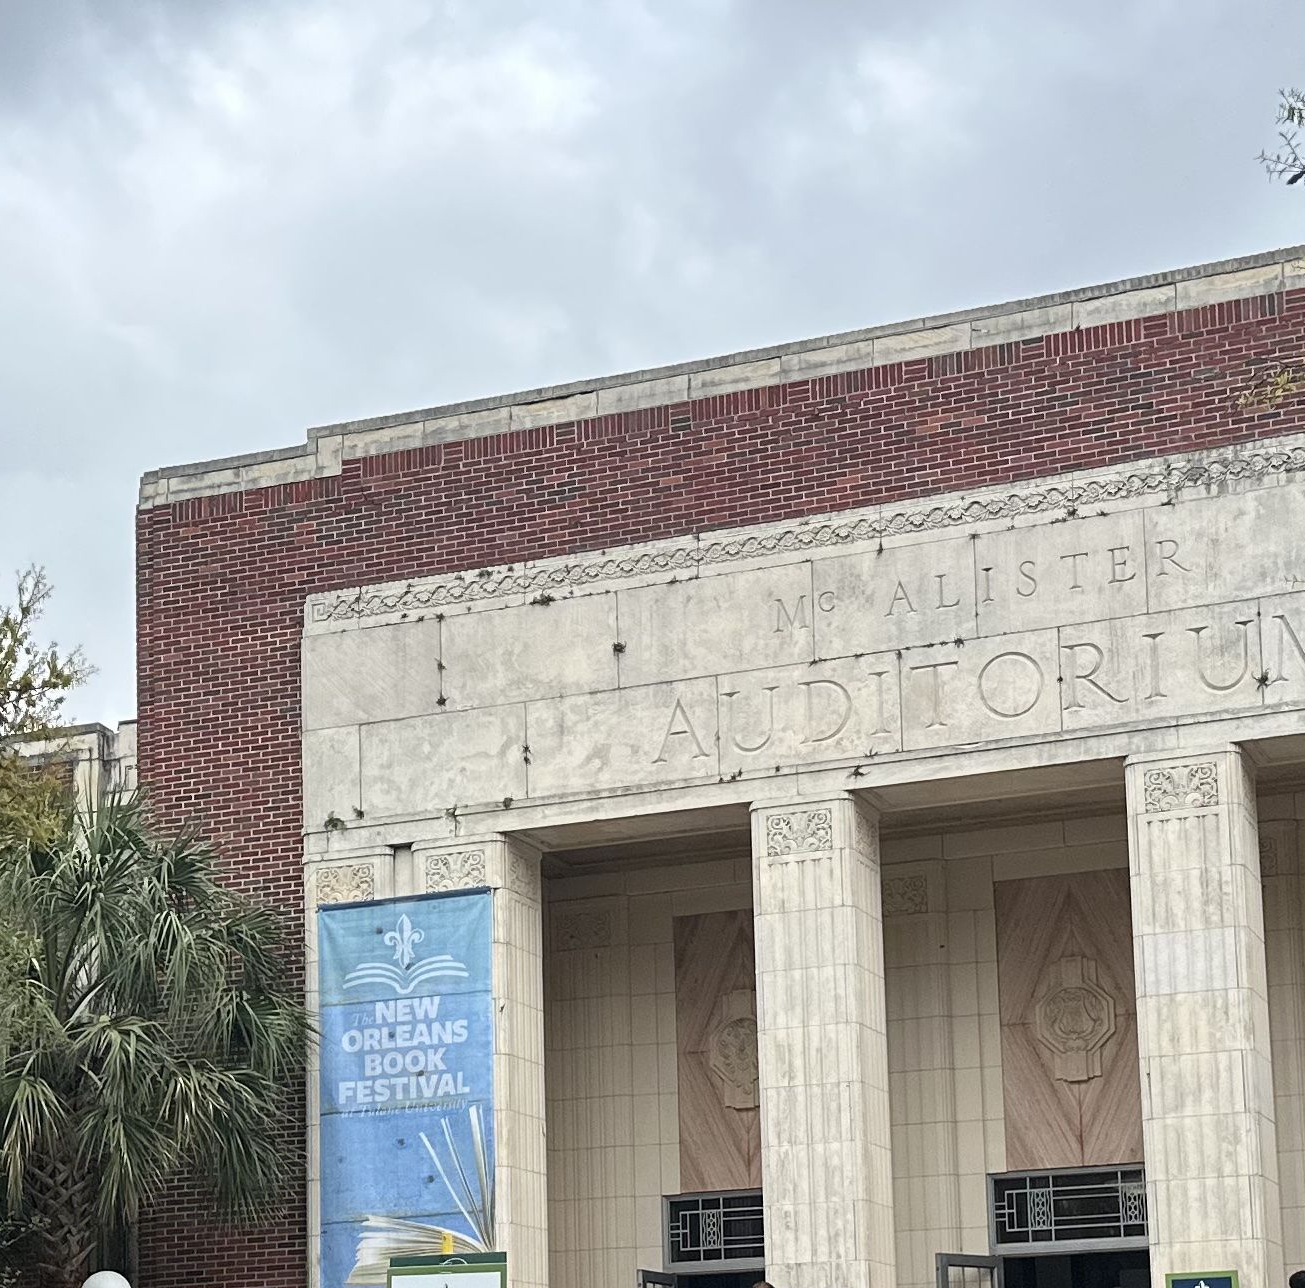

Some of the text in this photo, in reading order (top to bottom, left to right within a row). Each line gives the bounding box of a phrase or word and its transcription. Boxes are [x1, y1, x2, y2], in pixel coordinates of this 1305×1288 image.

[884, 538, 1194, 617] ALISTER
[352, 995, 441, 1028] The NEW
[341, 1020, 469, 1053] ORLEANS
[364, 1047, 447, 1077] BOOK
[338, 1071, 470, 1105] FESTIVAL
